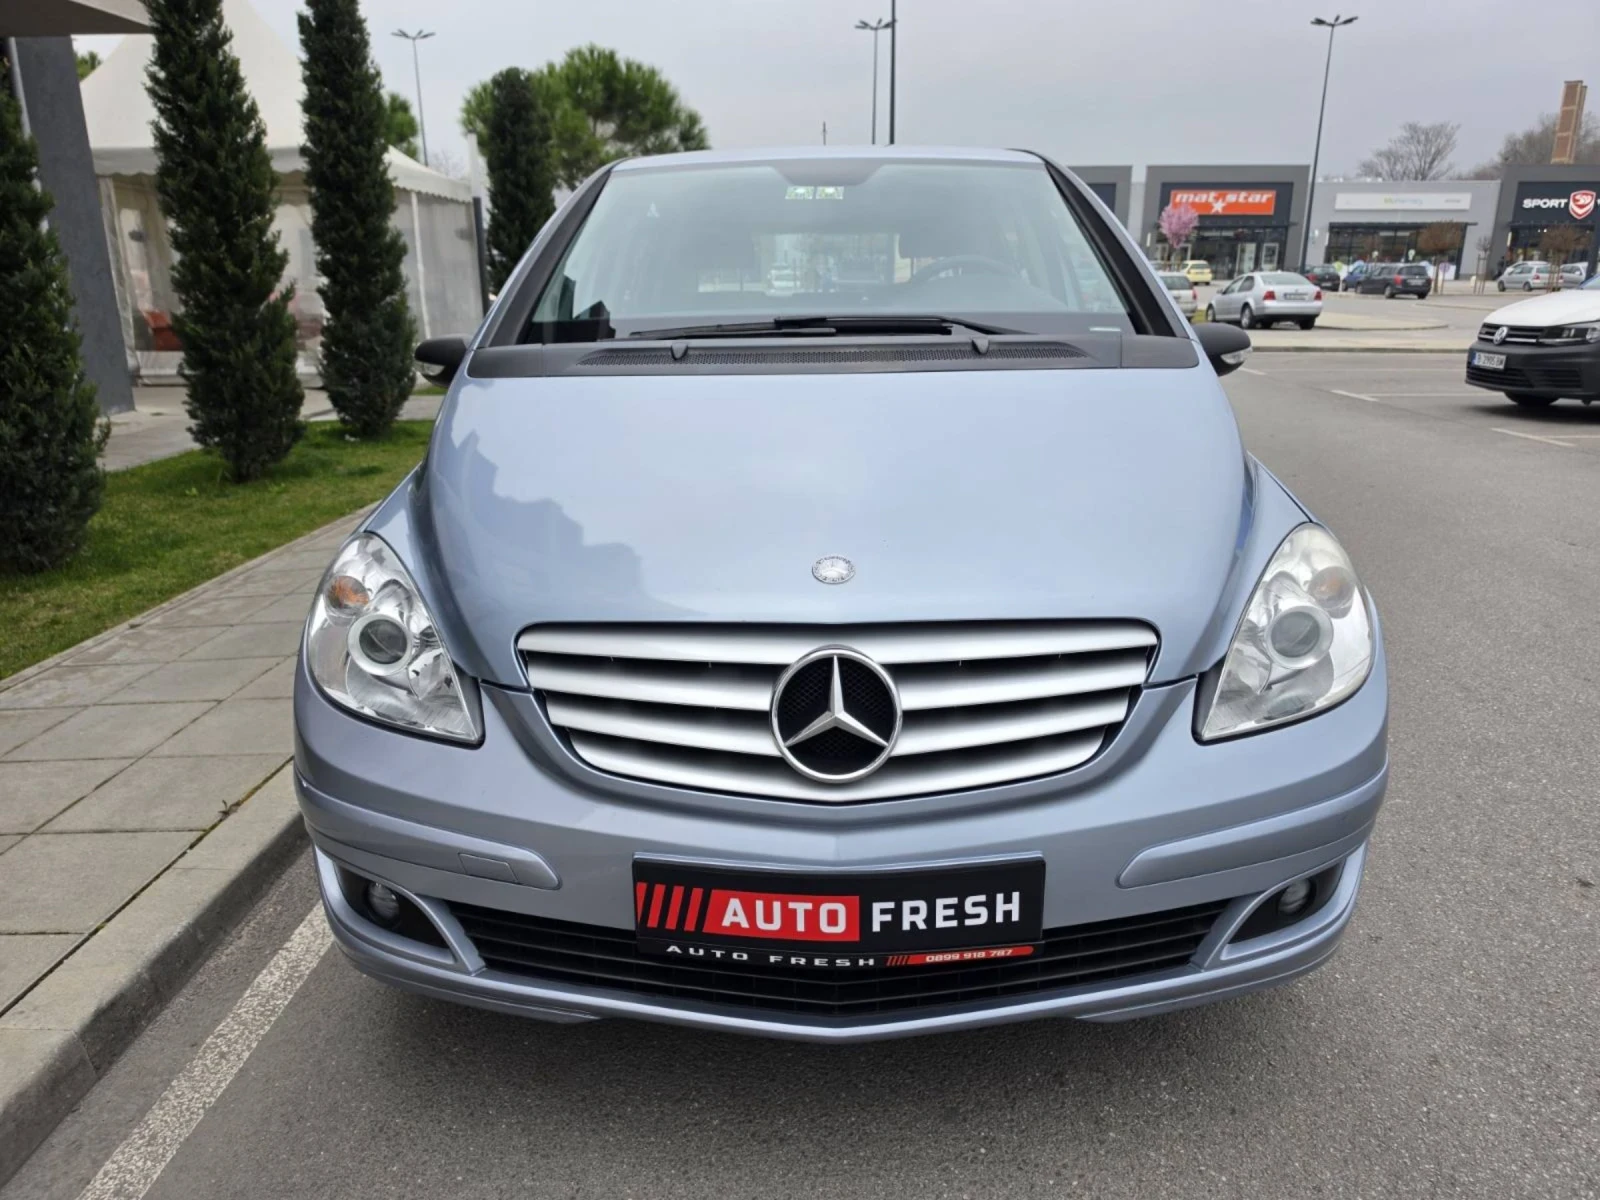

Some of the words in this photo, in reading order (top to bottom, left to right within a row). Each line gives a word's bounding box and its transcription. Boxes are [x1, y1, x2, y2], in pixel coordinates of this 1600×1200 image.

[1175, 192, 1217, 203] mat
[1225, 192, 1273, 203] star
[1522, 198, 1568, 209] SPORT
[721, 897, 847, 934] AUTO
[871, 891, 1020, 933] FRESH
[666, 945, 749, 961] AUTO
[769, 955, 875, 967] FRESH
[925, 951, 960, 963] 0899
[963, 950, 986, 960] 918
[989, 948, 1013, 958] 787
